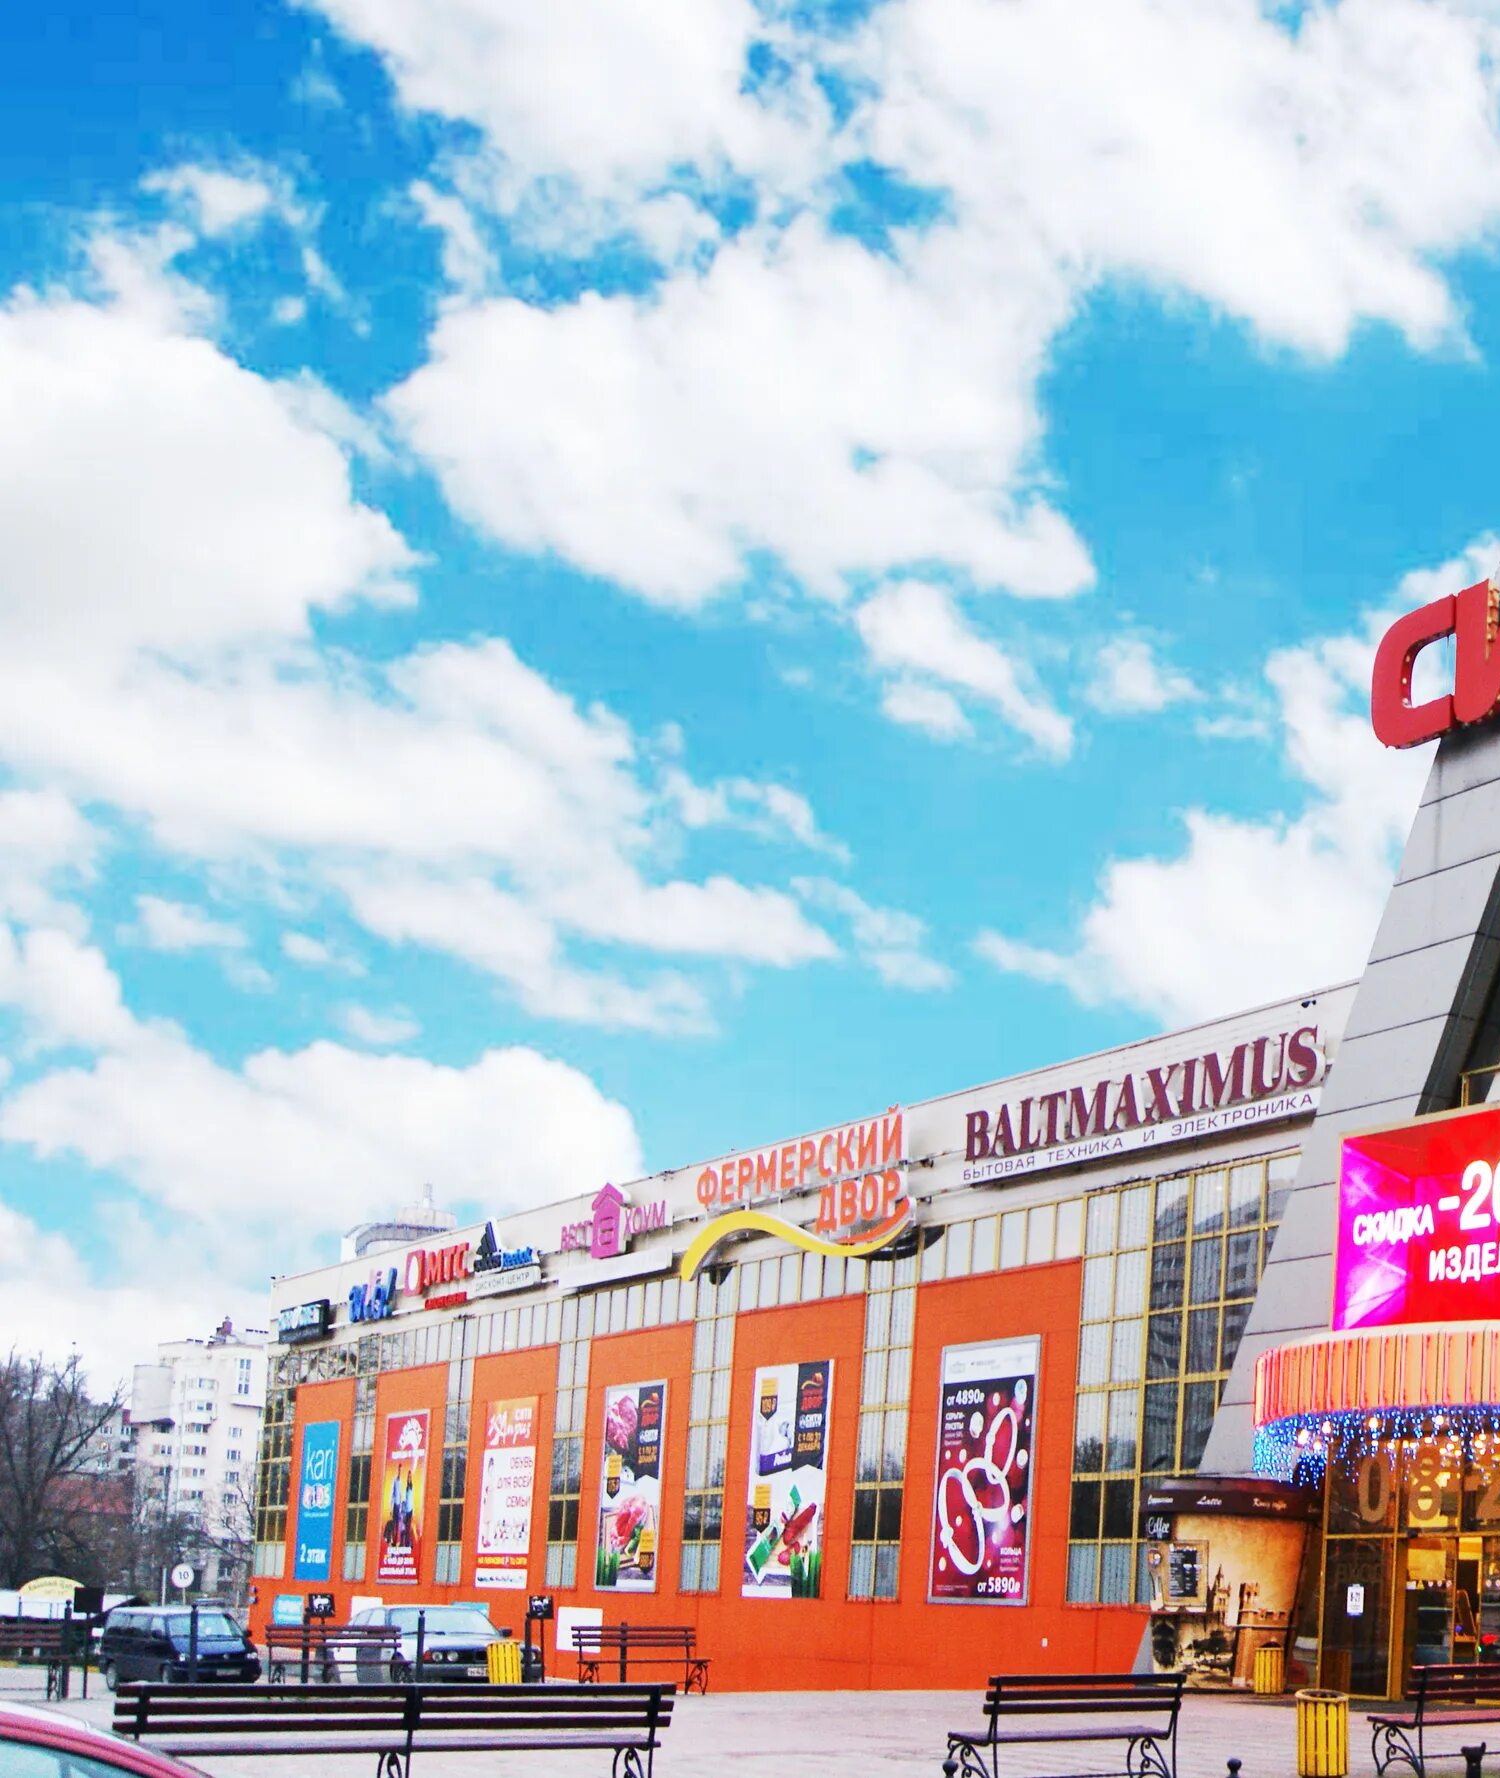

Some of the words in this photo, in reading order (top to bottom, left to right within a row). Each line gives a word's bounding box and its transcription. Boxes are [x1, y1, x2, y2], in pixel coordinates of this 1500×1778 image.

[964, 1024, 1319, 1163] BALTMAXIMUS
[696, 1104, 903, 1208] ФЕРМЕРСКИЙ
[963, 1155, 1035, 1181] БЫТОВАЯ
[1048, 1137, 1124, 1164] ТЕХНИКА
[1143, 1129, 1155, 1143] И
[1171, 1094, 1313, 1137] ЭЛЕКТРОНИКА
[815, 1169, 901, 1235] ДВОР
[1353, 1204, 1434, 1245] СКИДКА
[424, 1242, 470, 1287] МТС
[306, 1440, 335, 1480] kari
[1148, 1517, 1170, 1539] Coffee
[300, 1543, 306, 1563] 2
[178, 1571, 190, 1580] 10
[977, 1582, 987, 1593] от
